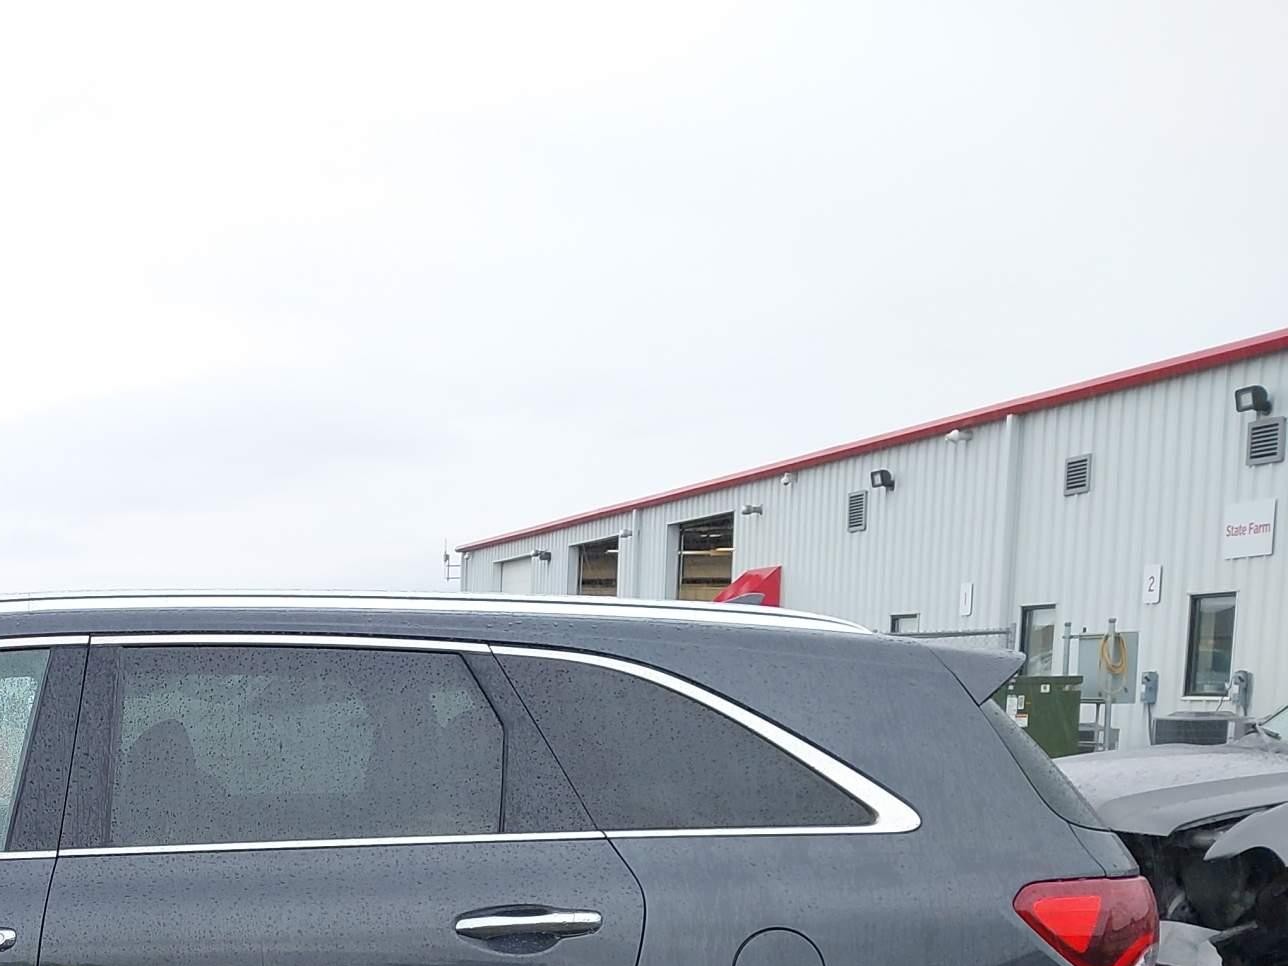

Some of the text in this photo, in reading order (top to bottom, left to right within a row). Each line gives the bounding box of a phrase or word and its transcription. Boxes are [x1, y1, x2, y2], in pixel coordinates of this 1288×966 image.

[1225, 521, 1271, 537] State Farm
[1148, 575, 1155, 592] 2
